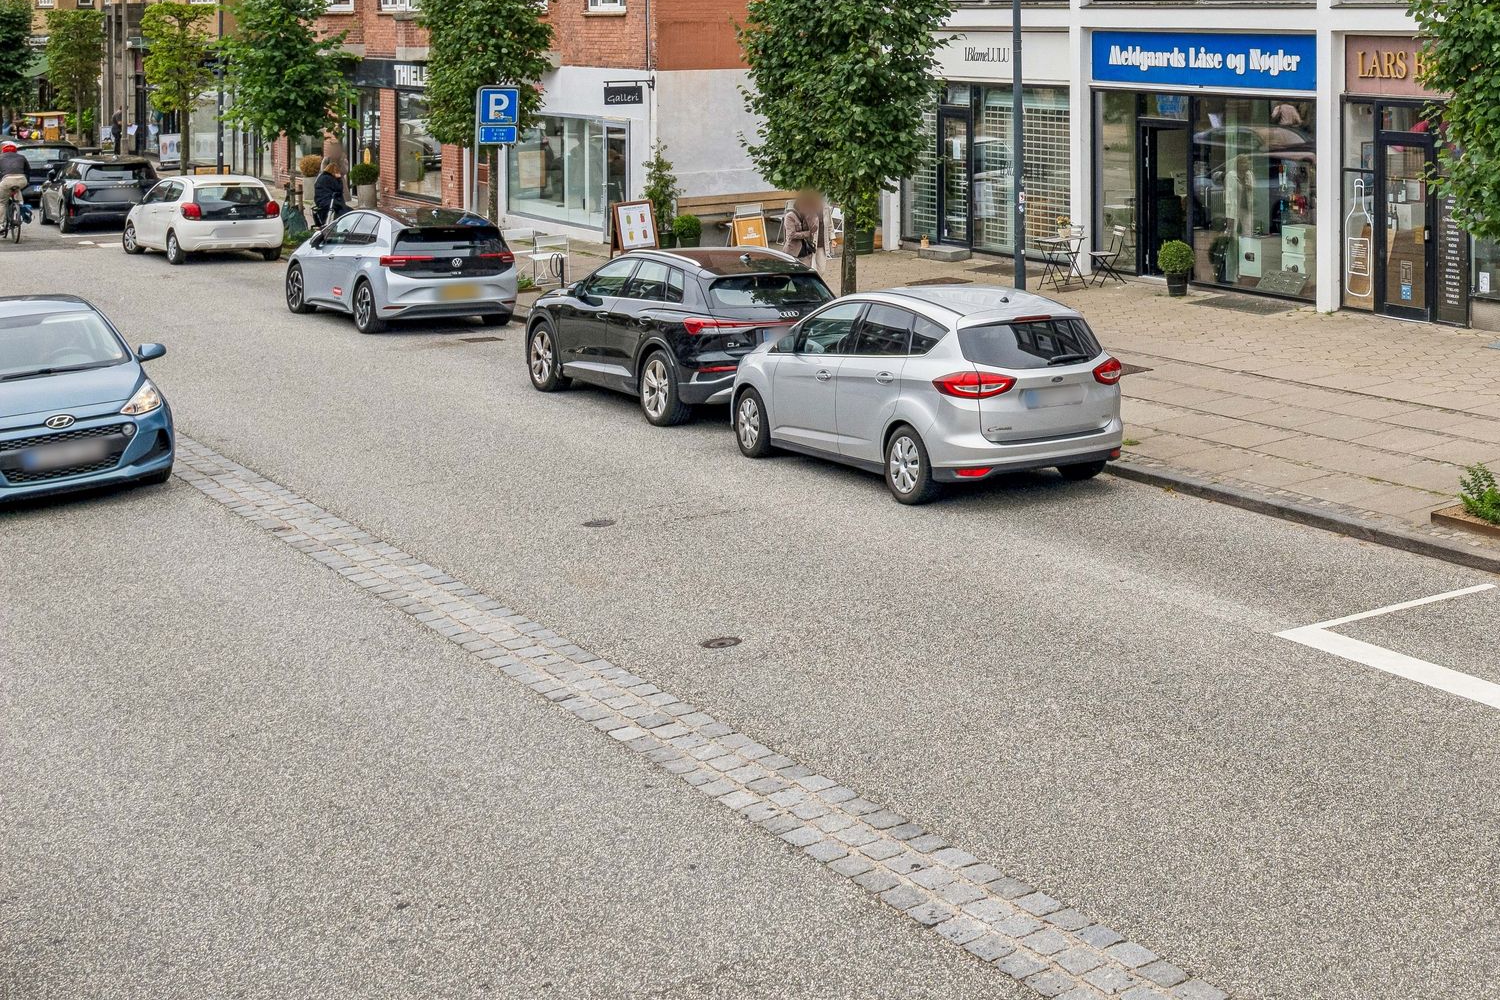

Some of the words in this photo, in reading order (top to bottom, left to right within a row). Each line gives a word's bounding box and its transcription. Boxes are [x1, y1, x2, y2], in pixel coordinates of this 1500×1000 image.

[1108, 45, 1187, 72] Meldgaards
[1188, 46, 1223, 69] Låse
[1226, 53, 1246, 76] og
[1249, 48, 1301, 77] Nøgler
[1356, 50, 1409, 79] LARS
[488, 93, 510, 120] P
[607, 92, 640, 104] Galleri
